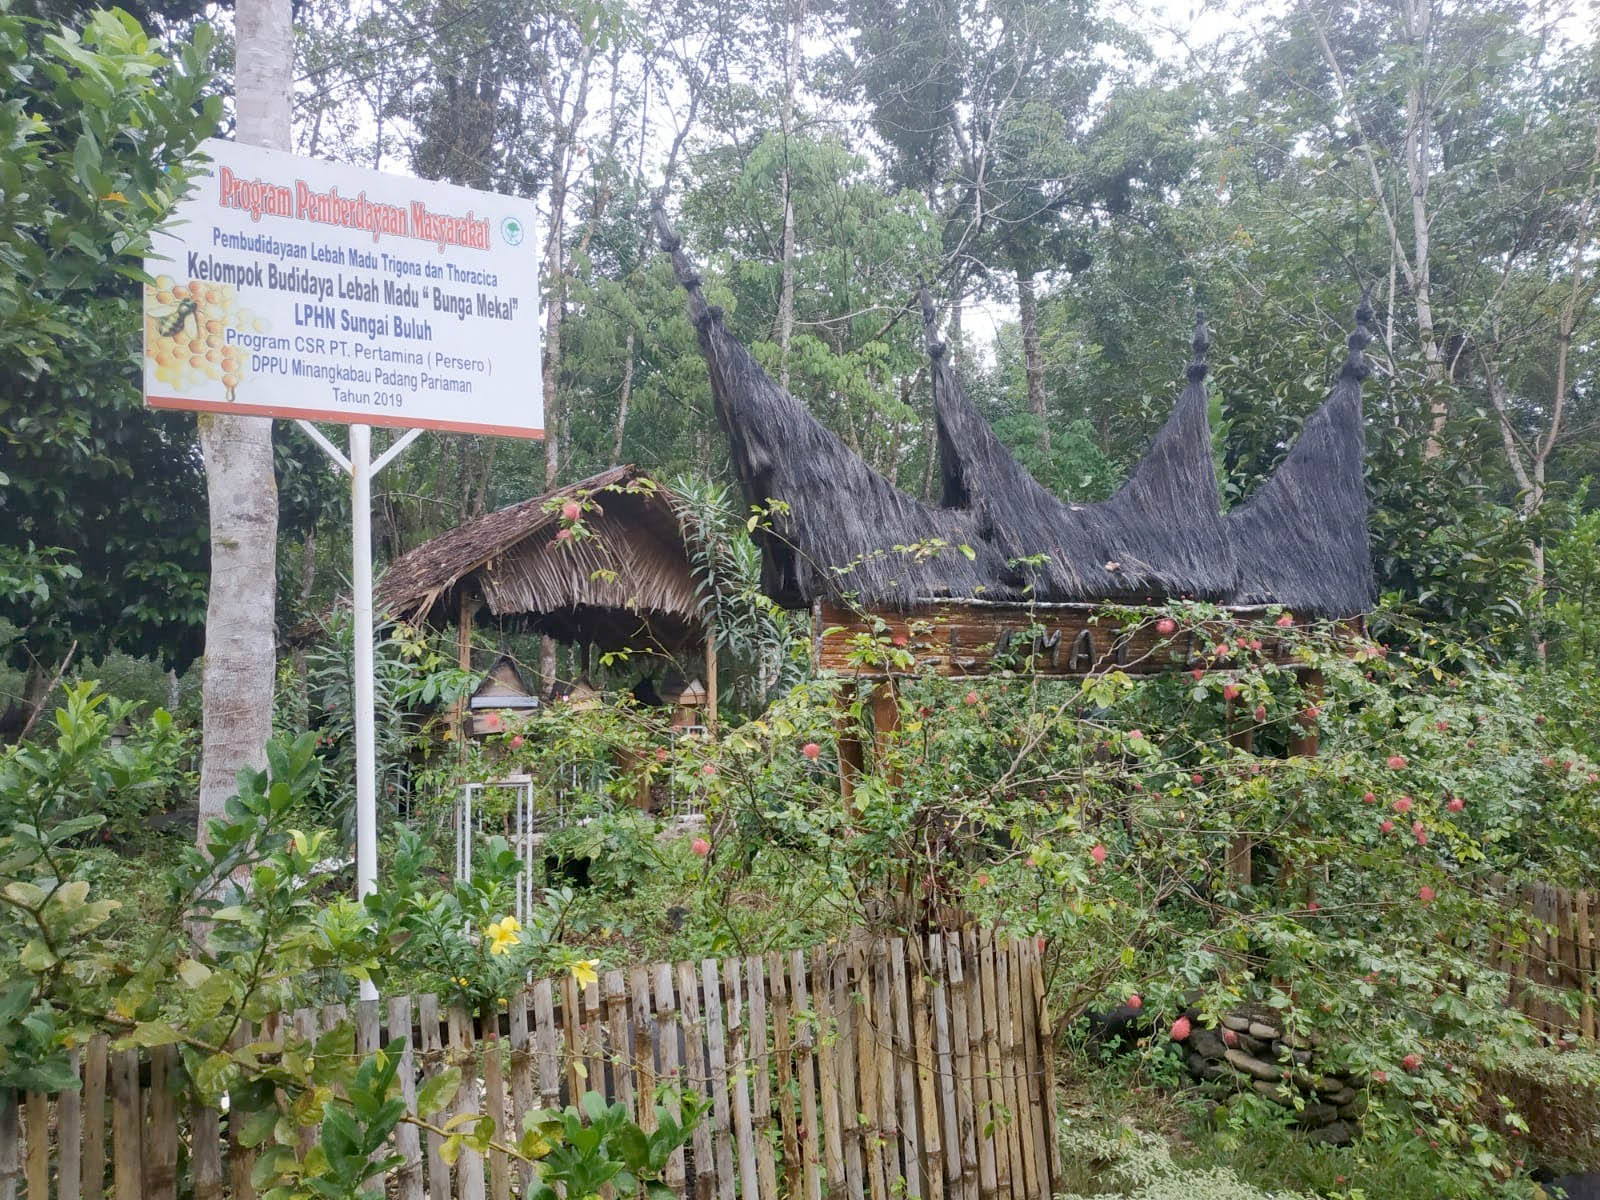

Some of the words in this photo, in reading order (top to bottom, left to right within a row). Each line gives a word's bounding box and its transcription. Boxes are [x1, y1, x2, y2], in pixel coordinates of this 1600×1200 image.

[220, 166, 292, 222] Program
[296, 179, 408, 242] Pemberdayaan
[411, 200, 490, 253] Masyarakat
[213, 226, 307, 261] Pembudidayaan
[311, 242, 345, 265] Lebah
[349, 248, 378, 270] Madu
[381, 253, 422, 278] Trigona
[425, 261, 443, 279] dan
[446, 263, 498, 287] Thoracica
[187, 250, 263, 291] Kelompok
[268, 263, 334, 302] Budidaya
[338, 273, 379, 303] Lebah
[384, 280, 419, 308] Madu
[295, 303, 336, 329] LPHN
[341, 309, 389, 340] Sungai
[393, 315, 432, 341] Buluh
[226, 328, 290, 351] Program
[295, 336, 326, 354] CSR
[330, 340, 351, 358] PT.
[354, 343, 424, 365] Pertamina
[252, 355, 288, 374] DPPU
[292, 359, 372, 383] Minangkabau
[375, 367, 418, 392] Padang
[421, 372, 472, 393] Pariaman
[332, 387, 370, 404] Tahun
[374, 391, 403, 408] 2019
